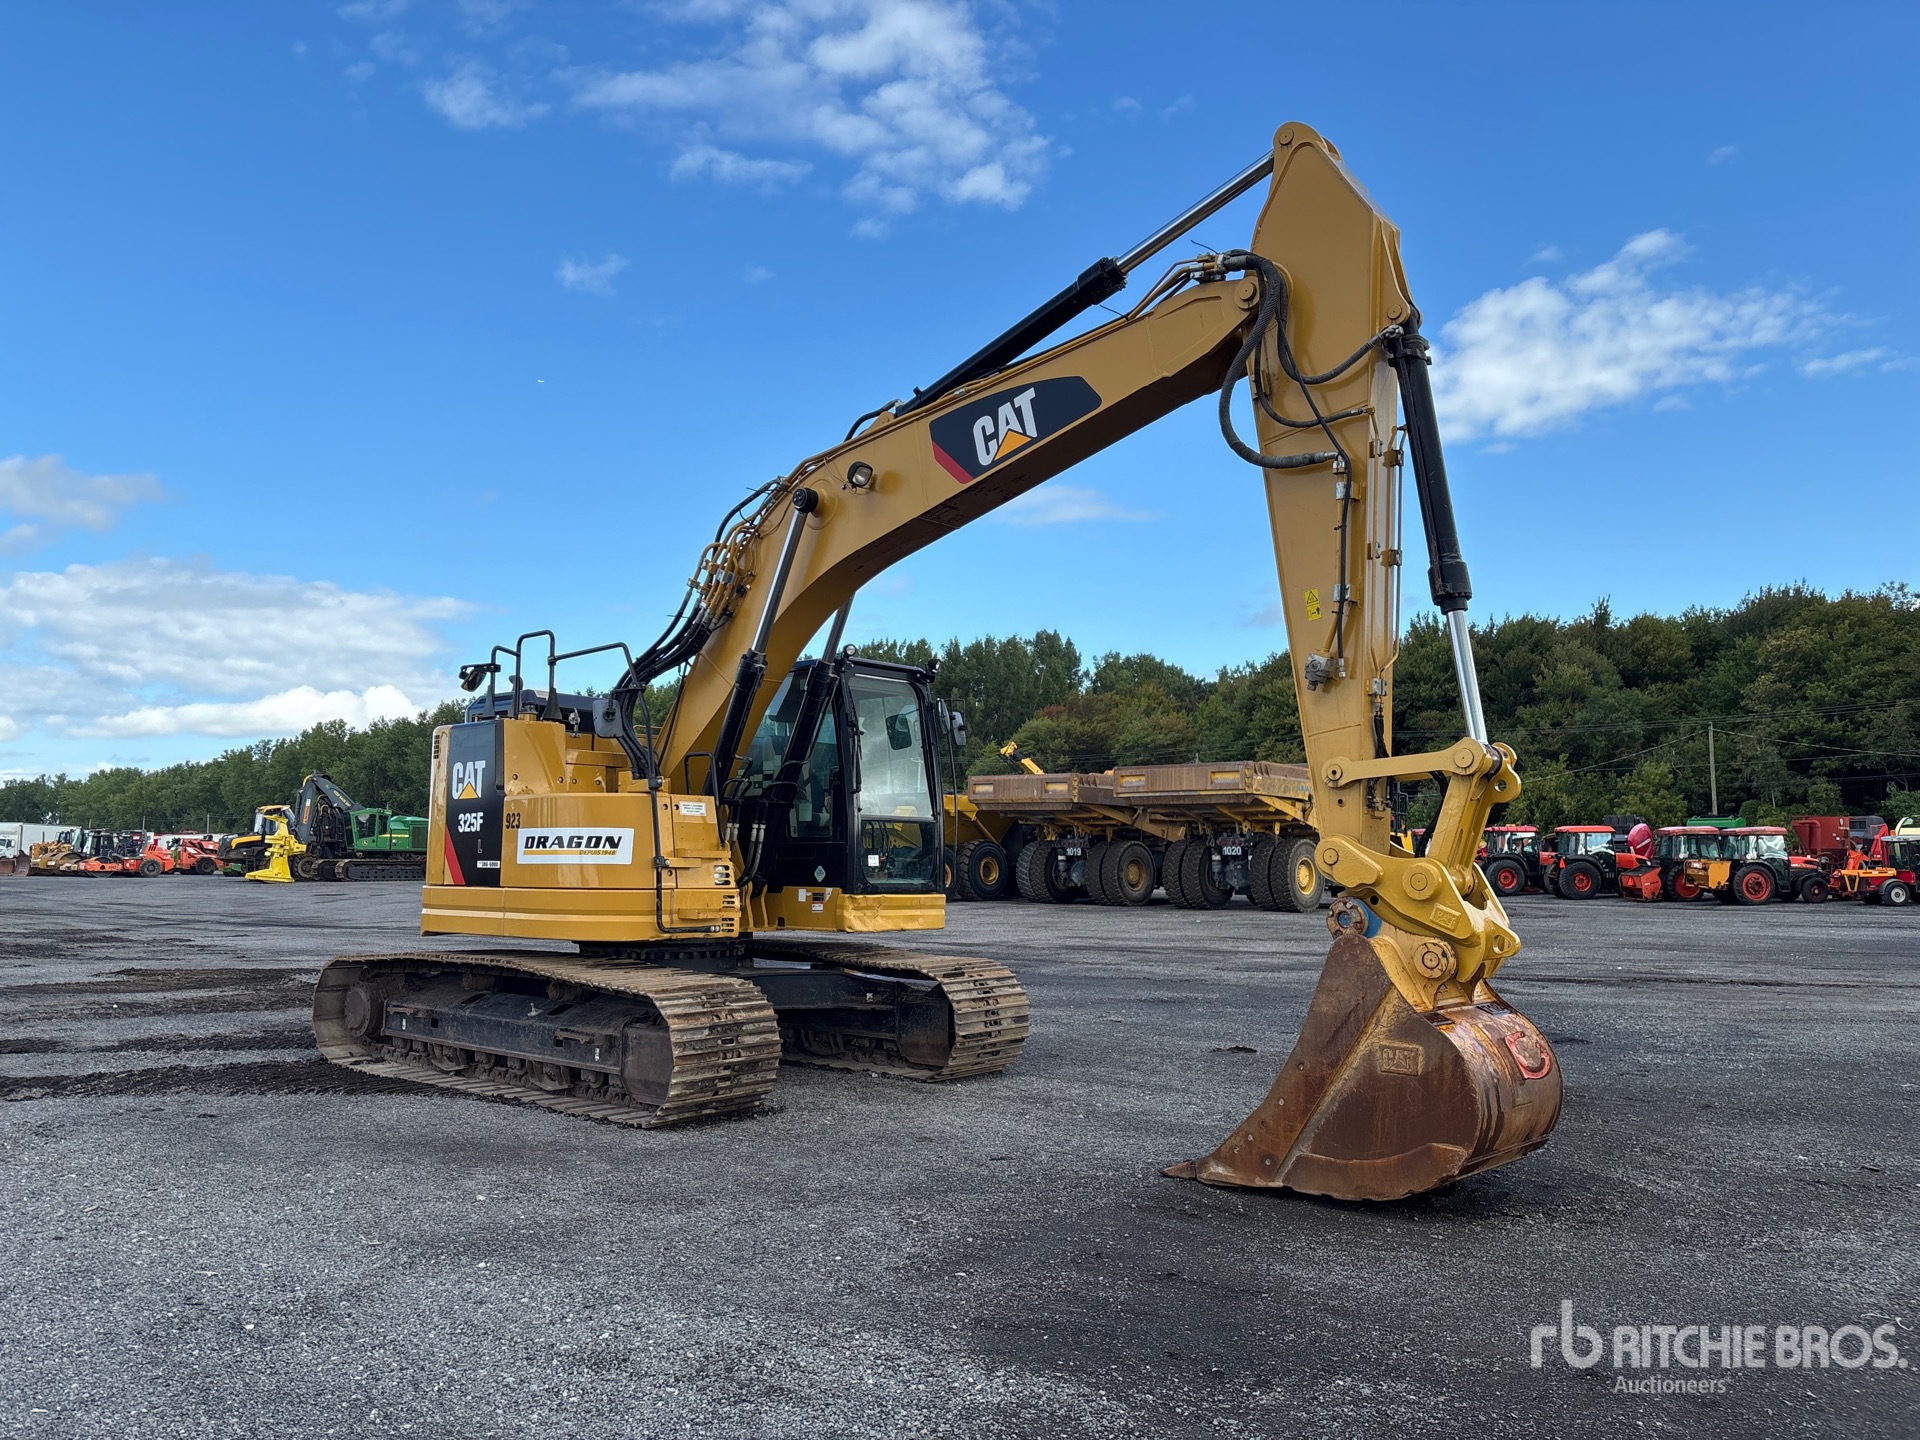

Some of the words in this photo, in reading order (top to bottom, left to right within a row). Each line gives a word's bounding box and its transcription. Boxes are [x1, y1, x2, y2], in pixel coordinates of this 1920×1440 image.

[973, 387, 1038, 466] CAT
[452, 760, 486, 799] CAT
[458, 812, 484, 833] 325F
[505, 812, 521, 829] 923
[524, 835, 622, 849] DRAGON
[579, 849, 601, 857] DEPUIS
[1066, 847, 1082, 856] 1019
[1222, 846, 1242, 856] 1020
[1382, 1048, 1414, 1070] CAT
